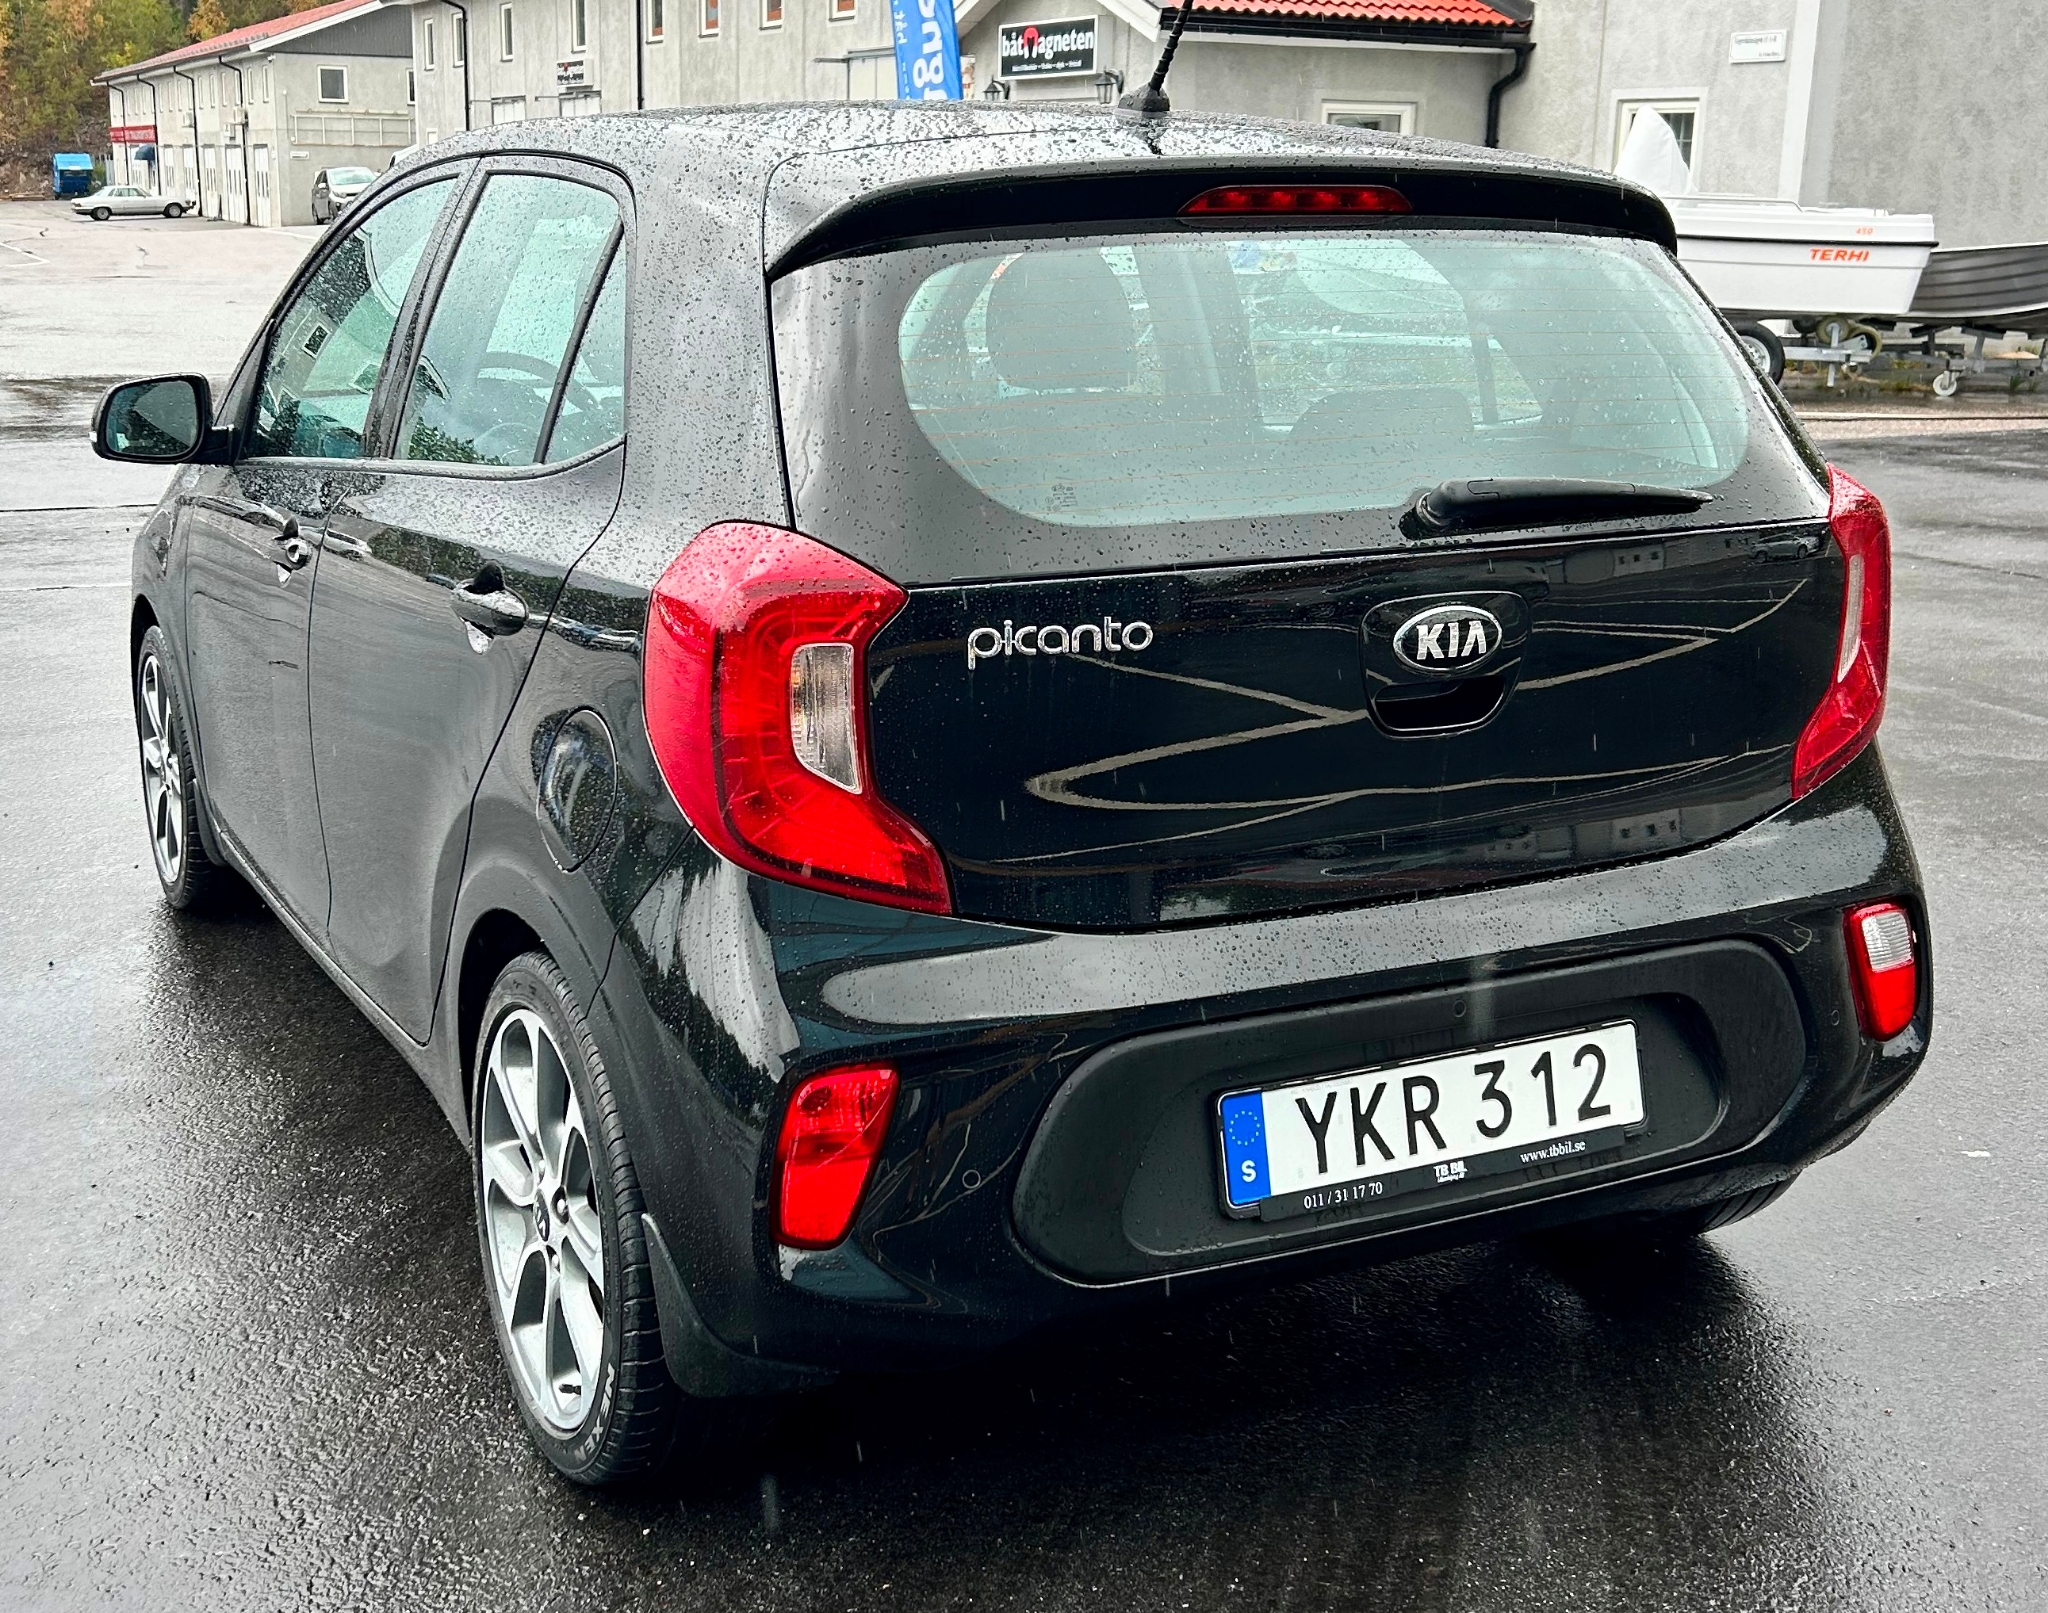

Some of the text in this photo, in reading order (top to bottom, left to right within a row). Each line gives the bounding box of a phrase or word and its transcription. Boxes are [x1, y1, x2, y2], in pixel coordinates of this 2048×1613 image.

[1810, 248, 1870, 262] TERHI
[967, 616, 1153, 671] picanto
[1416, 620, 1487, 660] KIA
[1294, 1043, 1612, 1175] YKR 312
[1520, 1141, 1586, 1163] www.tbbil.se
[1241, 1159, 1257, 1183] S
[1433, 1164, 1449, 1177] TB
[1303, 1193, 1324, 1209] 011
[1334, 1188, 1348, 1203] 31
[1353, 1184, 1366, 1200] 17
[1368, 1181, 1383, 1196] 70
[574, 1362, 615, 1461] NEXEN
